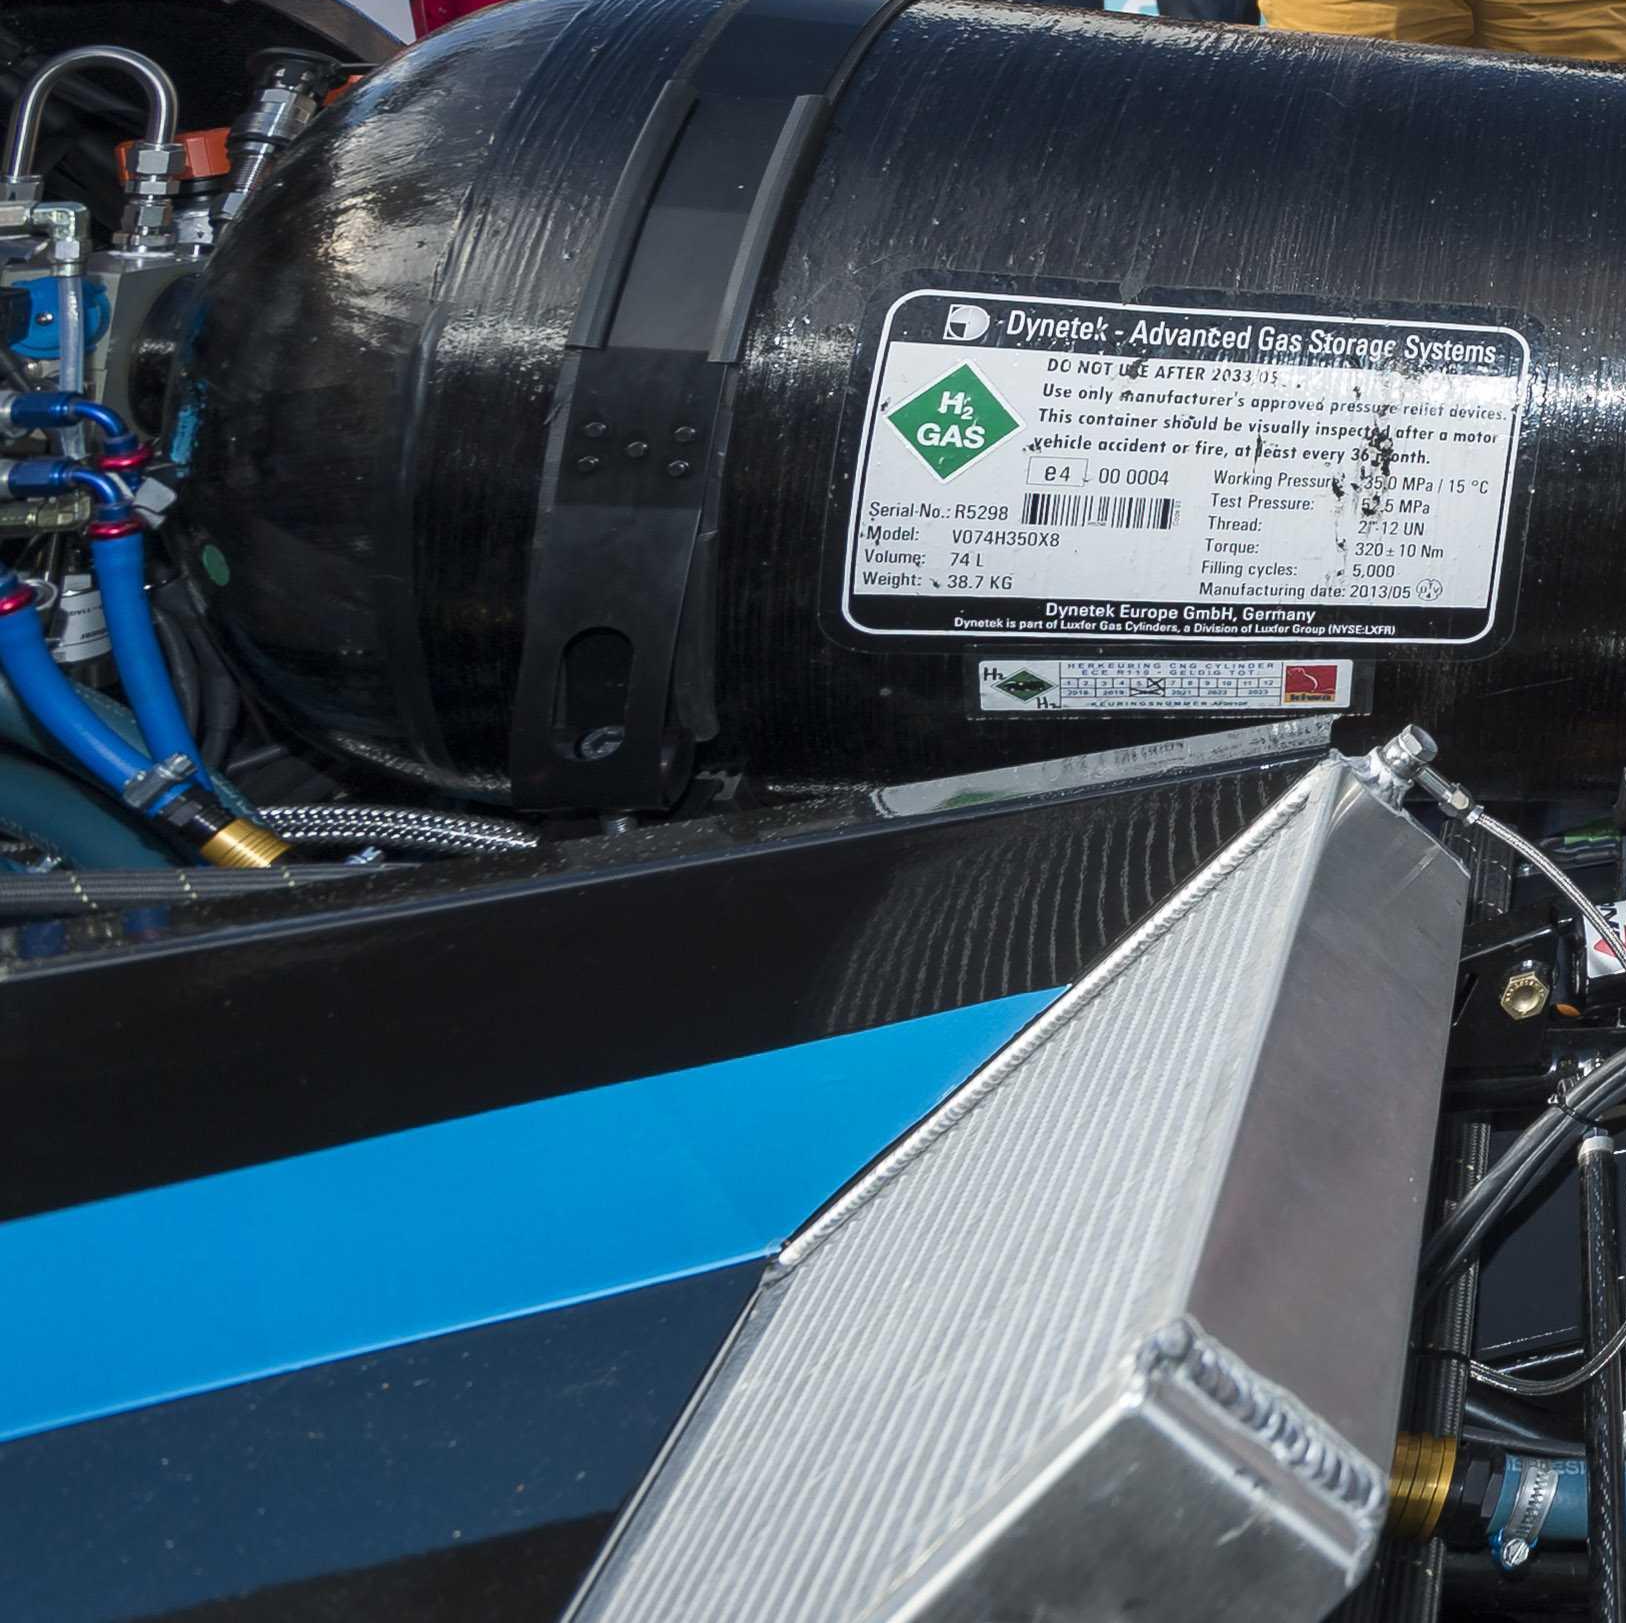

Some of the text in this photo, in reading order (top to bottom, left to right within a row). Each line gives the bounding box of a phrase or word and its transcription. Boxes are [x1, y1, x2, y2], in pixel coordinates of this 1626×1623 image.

[1006, 309, 1109, 342] Dynetek
[1129, 319, 1252, 350] Advanced
[1258, 326, 1302, 354] Gas
[1309, 329, 1397, 362] Storage
[1404, 334, 1498, 365] Systems
[1047, 358, 1072, 373] DO
[1077, 360, 1113, 376] NOT
[1155, 365, 1205, 381] AFTER
[1043, 384, 1508, 422] Use only manufacturer's approved pressure relief devices.
[1038, 408, 1498, 444] This container should be visually inspected after a motor
[916, 424, 986, 450] GAS
[1032, 434, 1431, 465] vehicle accident or fire, at least every 36 month.
[1044, 464, 1170, 486] e4 00 0004
[1213, 469, 1273, 490] Working
[1402, 477, 1434, 494] MPa
[1449, 479, 1465, 494] 15
[1471, 480, 1489, 495] °C
[869, 502, 1009, 521] Serial-No.: R5298
[1211, 493, 1243, 510] Test
[1248, 495, 1314, 511] Pressure:
[1400, 499, 1430, 515] MPa
[866, 526, 1060, 547] Model: V074H350X8
[1208, 515, 1262, 532] Thread:
[1403, 522, 1425, 537] UN
[864, 549, 985, 568] Volume: 74 L
[1204, 538, 1260, 555] Torque:
[1355, 542, 1384, 558] 320
[1399, 544, 1417, 558] 10
[1421, 544, 1444, 559] Nm
[1201, 560, 1243, 578] Filling
[1248, 563, 1298, 579] cycles:
[862, 572, 1013, 590] Weight: 38.7 KG
[1199, 582, 1411, 600] Manufacturing date: 2013/05
[1046, 603, 1316, 623] Dynetek Europe GmbH, Germany
[954, 617, 1004, 629] Dynetek
[1005, 619, 1016, 628] is
[1019, 619, 1043, 630] part
[1044, 619, 1058, 629] of
[1060, 620, 1097, 631] Luxfer
[1099, 621, 1123, 631] Gas
[1125, 621, 1181, 634] Cylinders,
[1194, 623, 1238, 635] Division
[1241, 624, 1253, 634] of
[1255, 624, 1291, 635] Luxfer
[1292, 625, 1325, 637] Group
[1068, 662, 1275, 670] HERKEURING CNG CYLINDER
